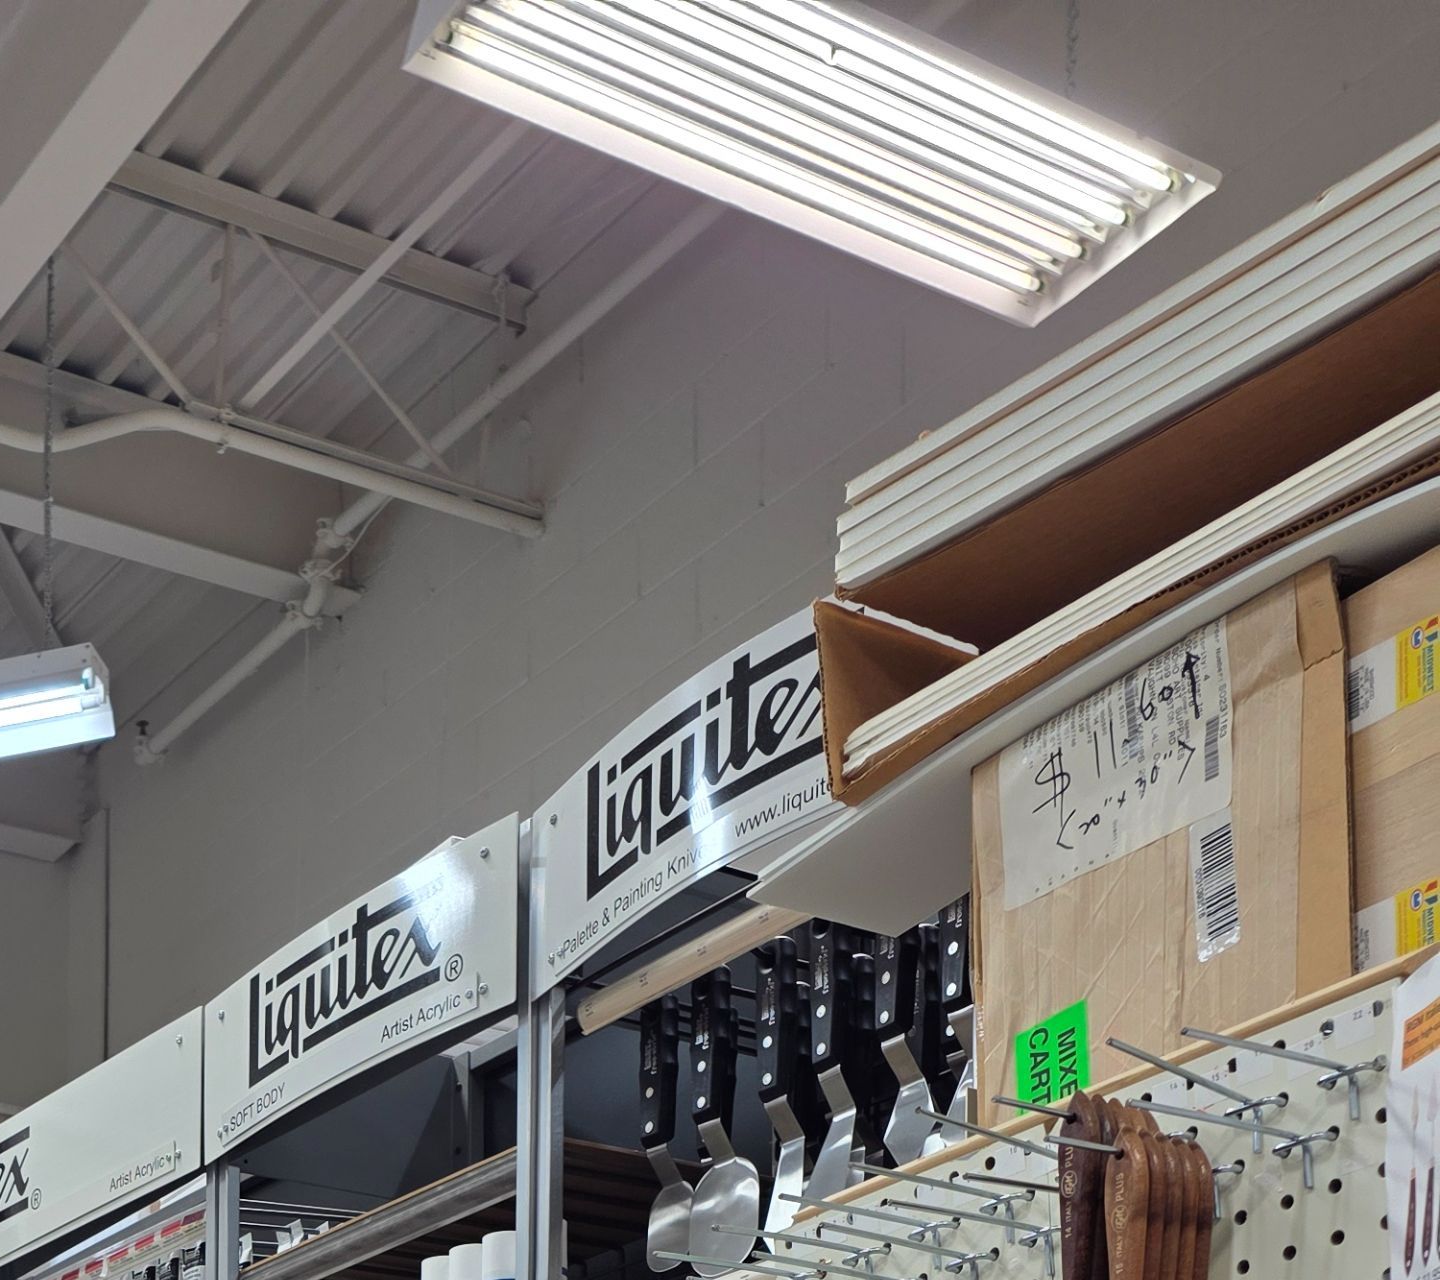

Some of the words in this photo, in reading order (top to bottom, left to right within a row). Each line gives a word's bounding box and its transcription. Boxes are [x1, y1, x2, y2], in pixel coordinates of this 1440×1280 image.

[1424, 645, 1436, 692] MIDWEST
[586, 634, 826, 901] Liquite
[562, 920, 599, 957] Palette
[601, 906, 612, 929] &
[614, 870, 663, 912] Painting
[1424, 907, 1435, 946] MIDWE
[248, 903, 444, 1088] Liquitex
[381, 1008, 414, 1043] Artist
[416, 991, 462, 1031] Acrylic
[1056, 1026, 1079, 1097] MIXE
[229, 1103, 256, 1132] SOFT
[257, 1083, 286, 1119] BODY
[109, 1168, 134, 1194] Artist
[135, 1155, 165, 1184] Acrylic
[1065, 1146, 1074, 1168] PLU
[1115, 1172, 1125, 1201] PLUS
